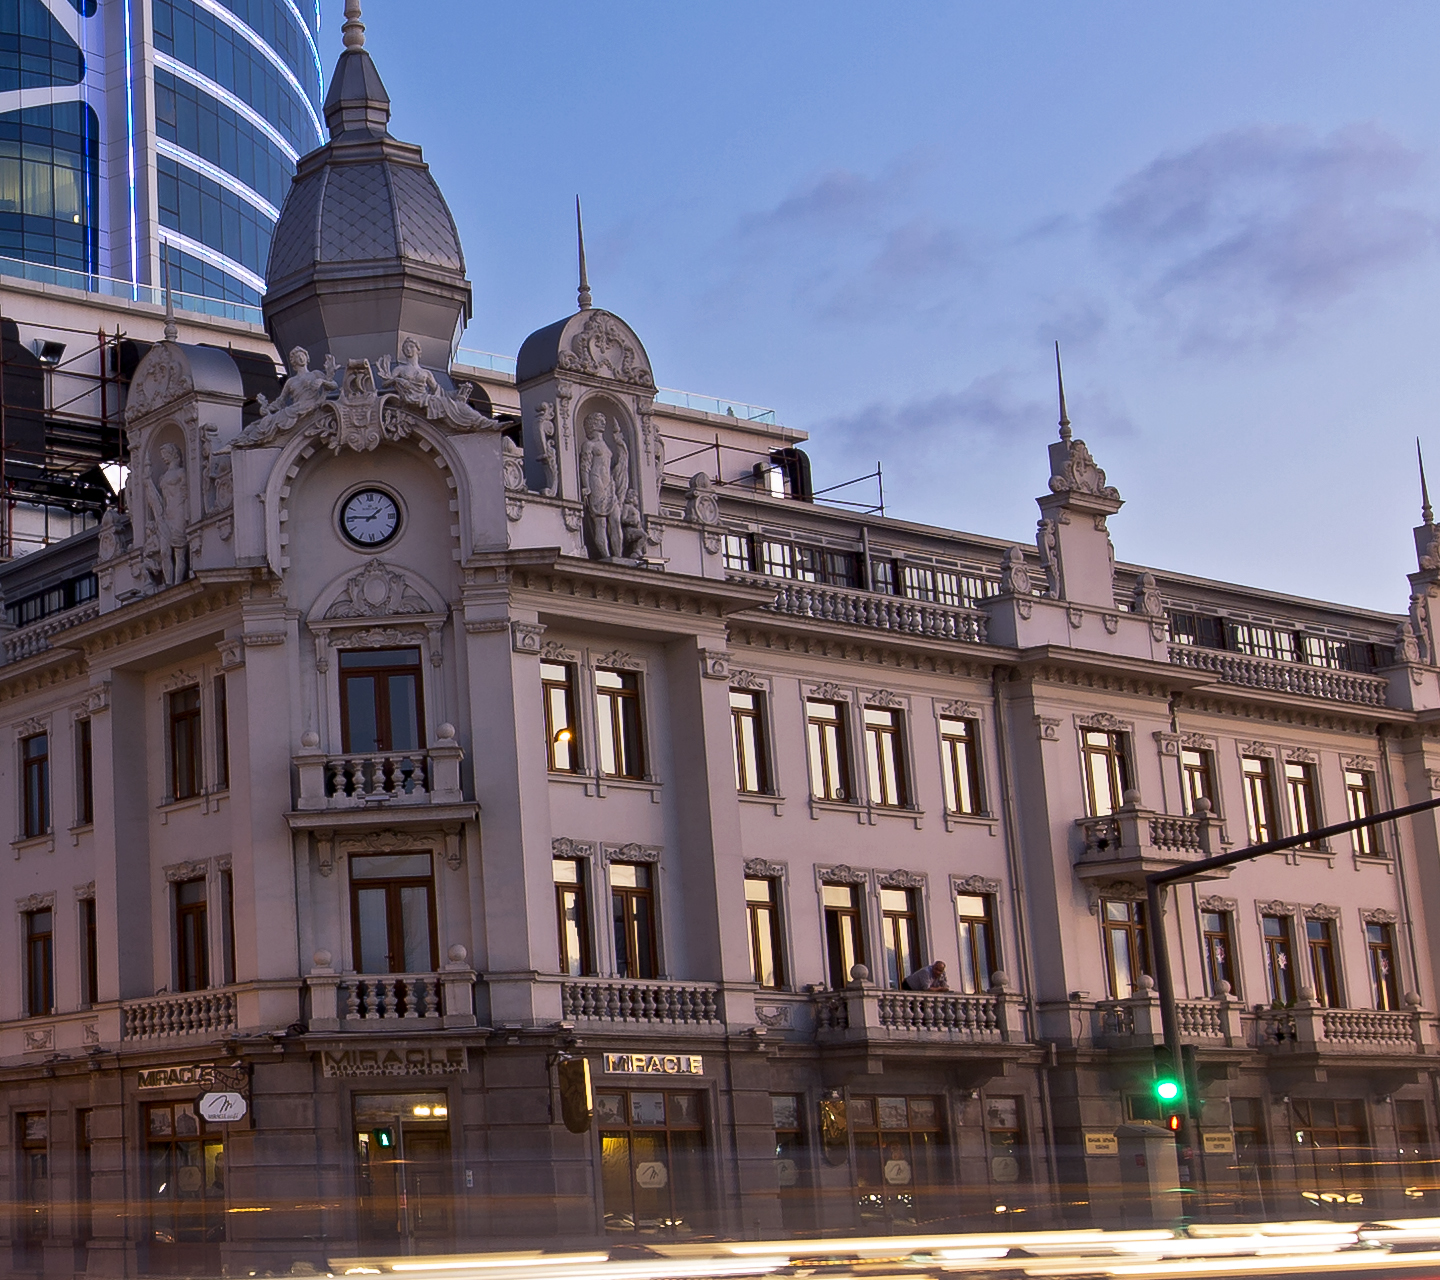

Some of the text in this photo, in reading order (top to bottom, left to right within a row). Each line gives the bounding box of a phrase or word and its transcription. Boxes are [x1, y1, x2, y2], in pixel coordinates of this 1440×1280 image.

[324, 1049, 464, 1066] MIRACLE
[606, 1054, 704, 1075] MIRACLE
[138, 1067, 216, 1088] MIRACLE
